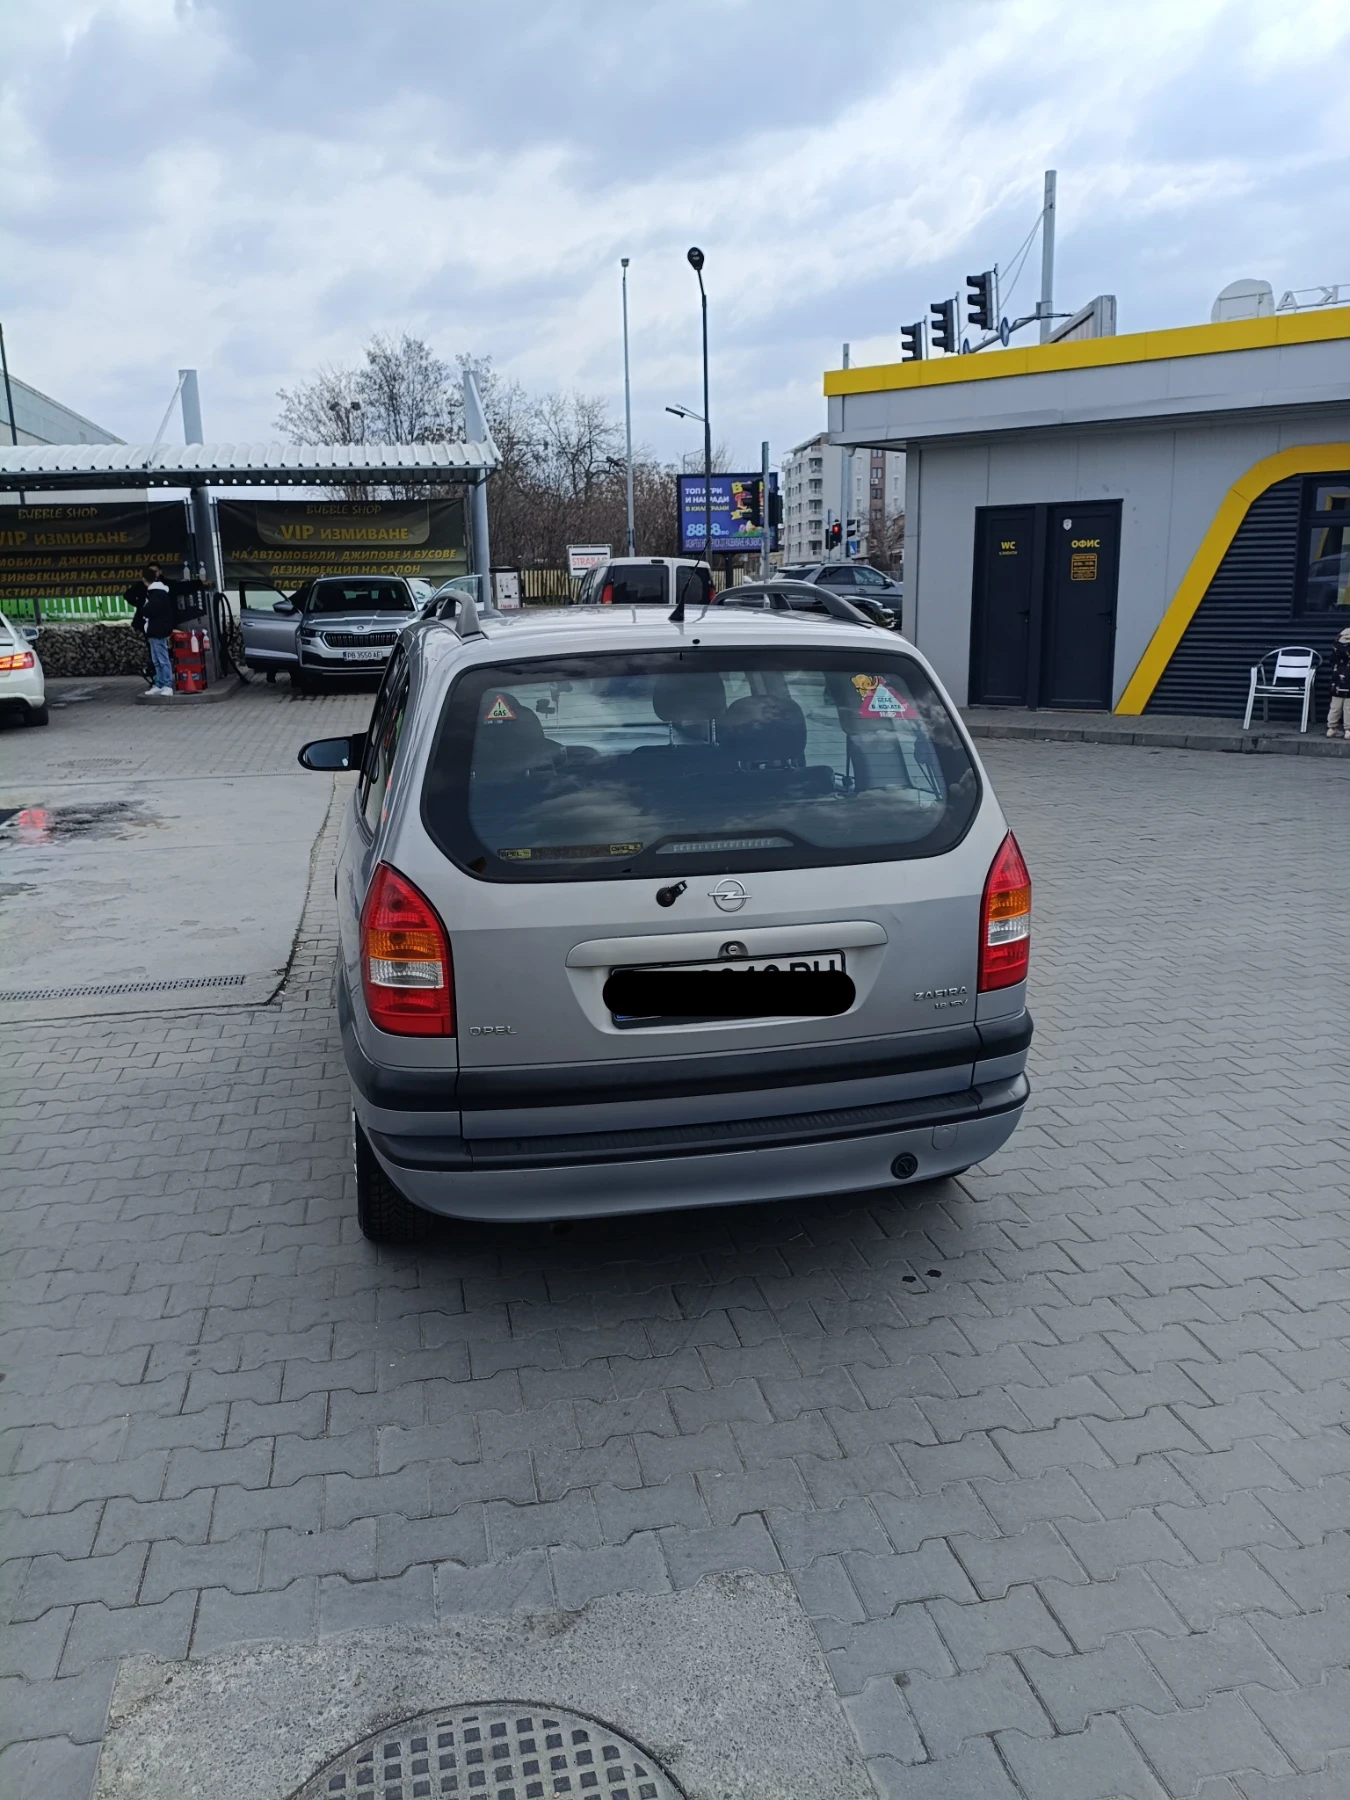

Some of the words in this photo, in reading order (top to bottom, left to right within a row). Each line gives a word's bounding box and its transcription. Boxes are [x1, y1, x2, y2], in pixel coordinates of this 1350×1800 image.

[18, 507, 63, 520] BUBBLE
[66, 507, 98, 518] SHOP
[306, 504, 349, 515] BUBBLE
[352, 504, 383, 515] SHOP
[34, 531, 129, 545] ИЗМИВАНЕ
[280, 525, 315, 540] VIP
[320, 527, 409, 540] ИЗМИВАНЕ
[1001, 541, 1015, 549] WC
[1071, 539, 1100, 548] ОФИС
[58, 553, 122, 567] ДЖИПОВЕ
[123, 555, 132, 564] И
[135, 552, 181, 563] БУСОВЕ
[231, 550, 248, 560] НА
[252, 549, 339, 561] АВТОМОБИЛИ,
[341, 549, 401, 561] ДЖИПОВЕ
[403, 550, 411, 559] И
[414, 548, 457, 559] БУСОВЕ
[80, 569, 98, 580] НА
[101, 568, 143, 580] САЛОН
[270, 564, 359, 576] ДЕЗИНФЕКЦИЯ
[361, 564, 379, 575] НА
[381, 563, 421, 575] САЛОН
[64, 585, 73, 596] И
[76, 584, 132, 596] ПОЛИРА
[914, 986, 968, 1001] ZAFIRA
[470, 1025, 518, 1036] OPEL
